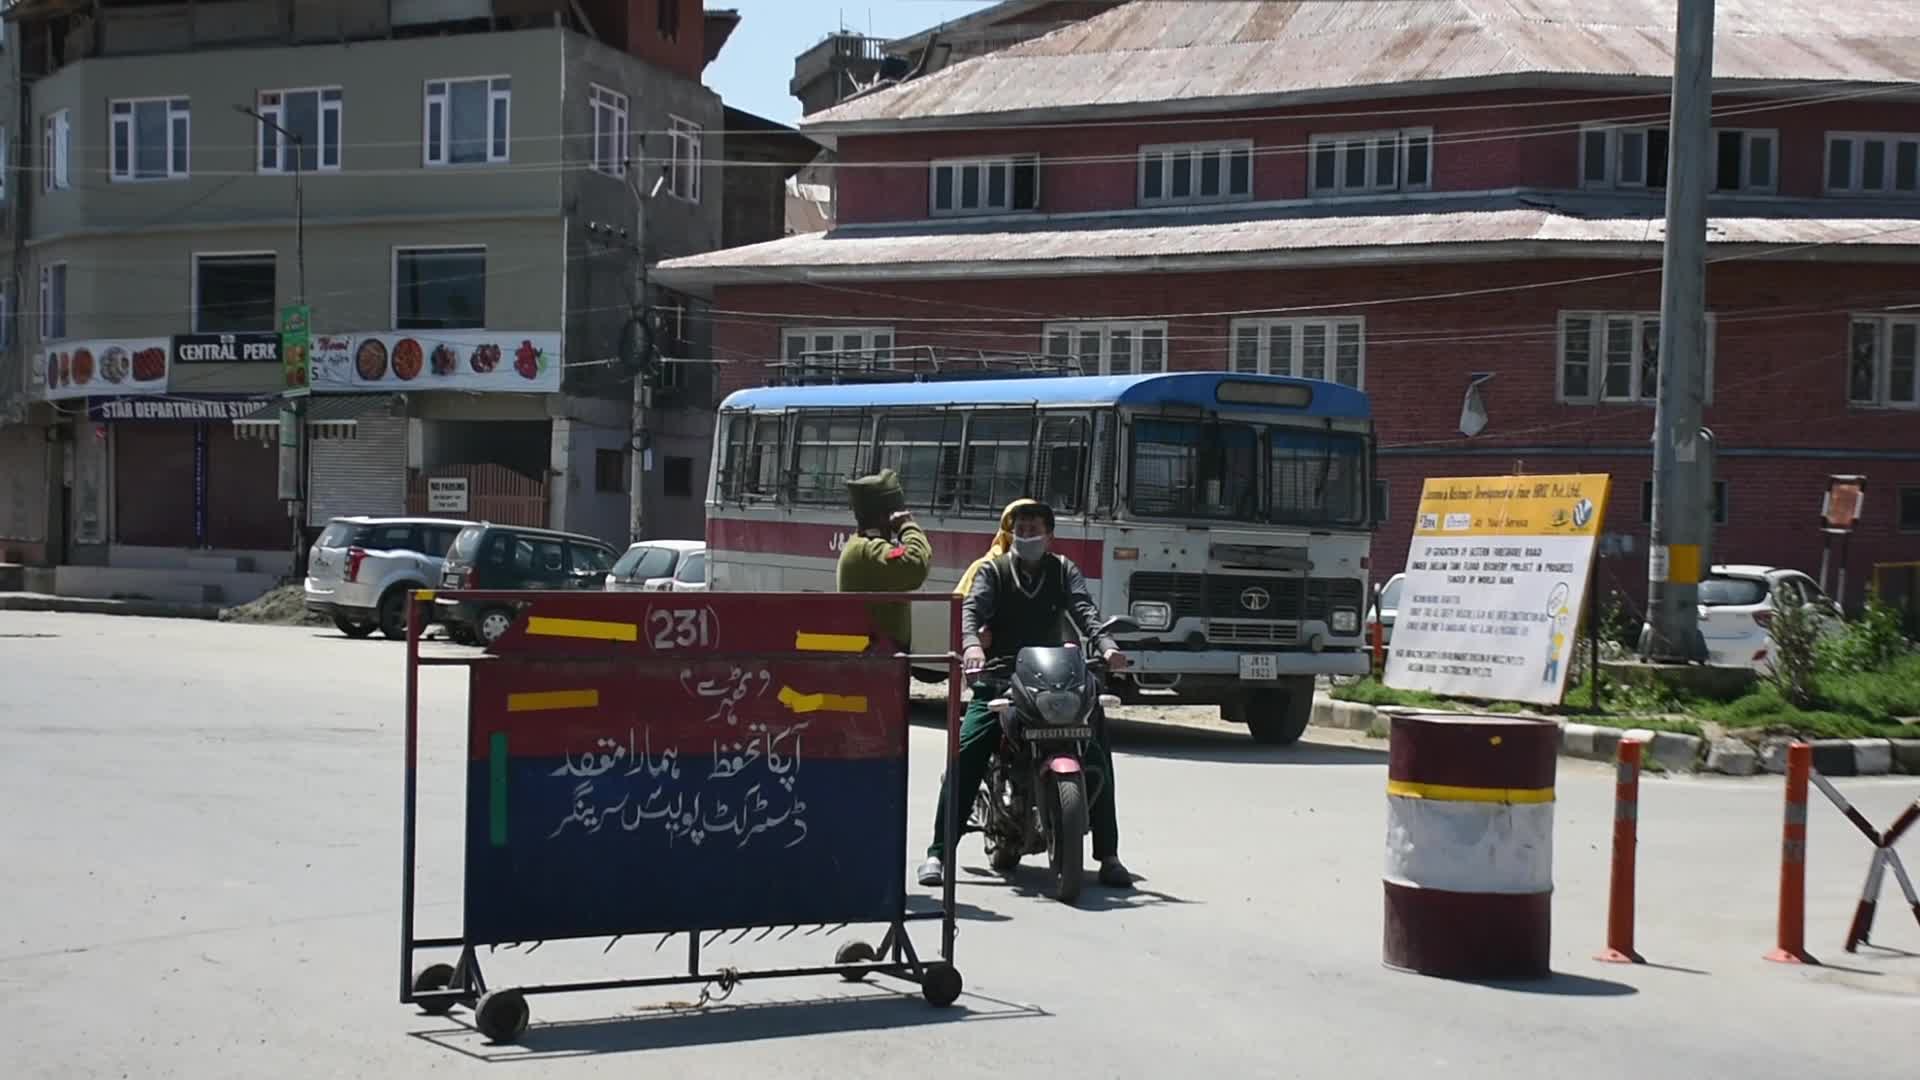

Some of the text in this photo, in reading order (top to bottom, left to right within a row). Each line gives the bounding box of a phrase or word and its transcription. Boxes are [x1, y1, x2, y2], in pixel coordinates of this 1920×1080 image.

[179, 344, 277, 361] CENTRAL PERK
[102, 402, 133, 419] STAR
[135, 401, 227, 419] DEPARTMENTAL
